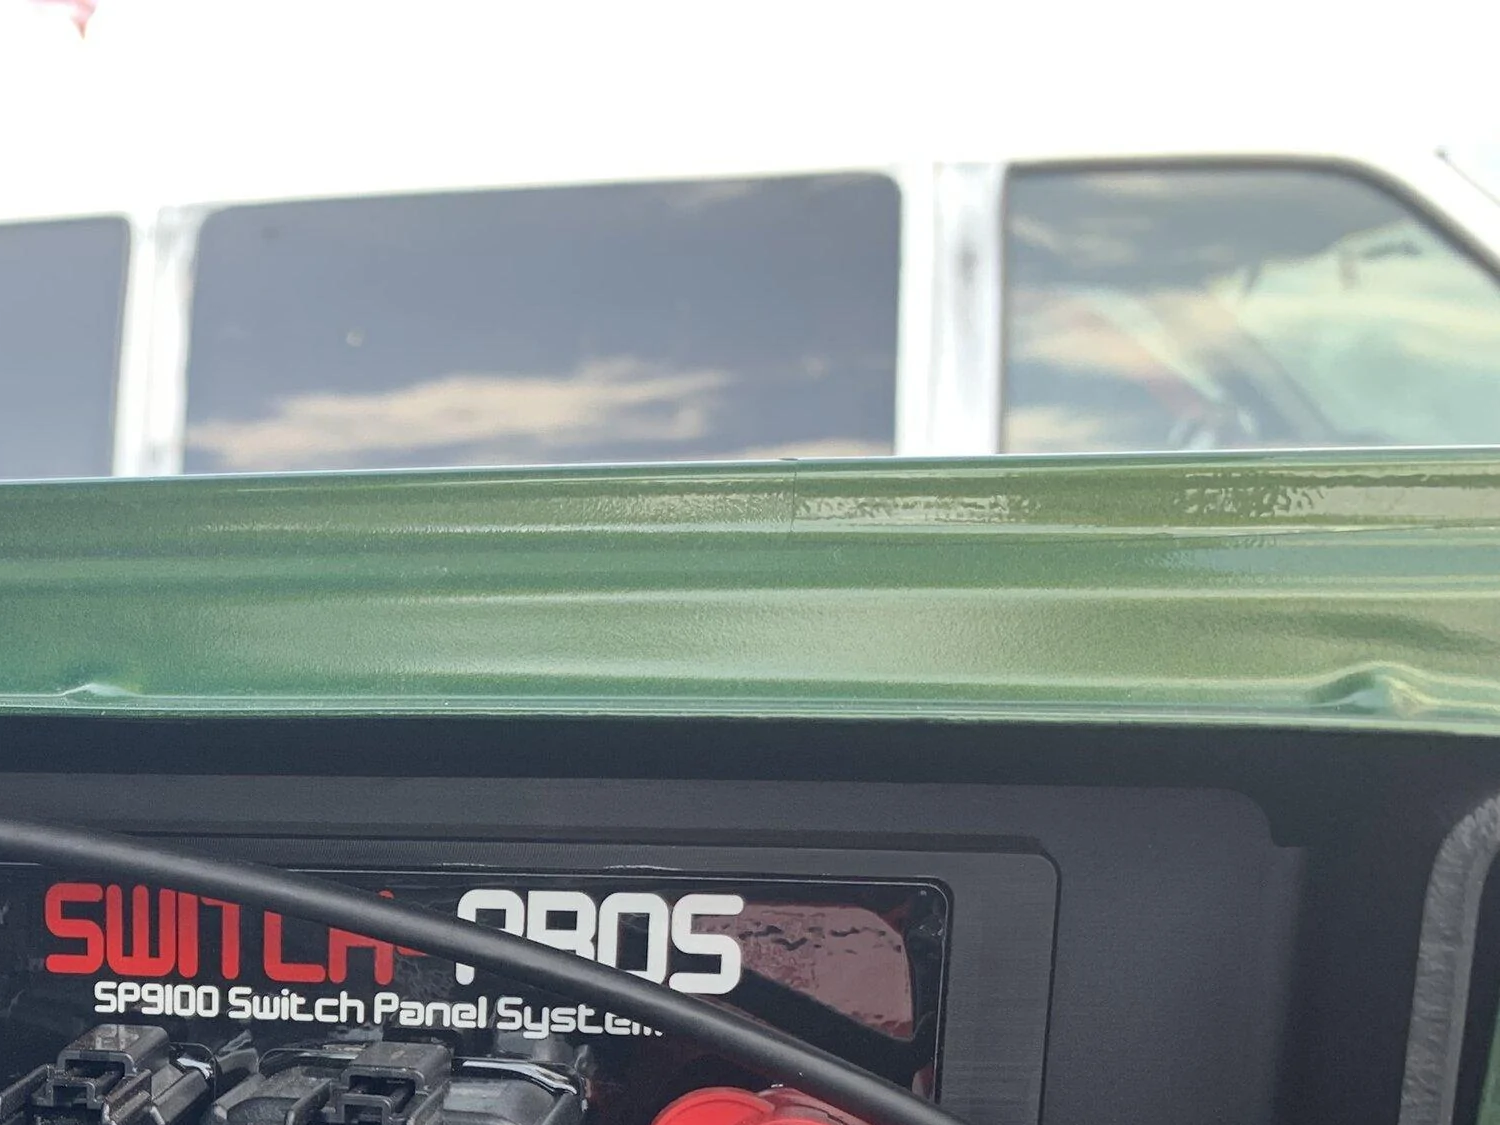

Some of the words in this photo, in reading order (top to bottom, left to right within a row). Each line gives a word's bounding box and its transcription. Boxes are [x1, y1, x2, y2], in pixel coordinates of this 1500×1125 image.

[94, 981, 220, 1018] SP9100
[227, 987, 365, 1024] Switch
[373, 991, 488, 1029] Panel
[496, 996, 664, 1040] Syste
